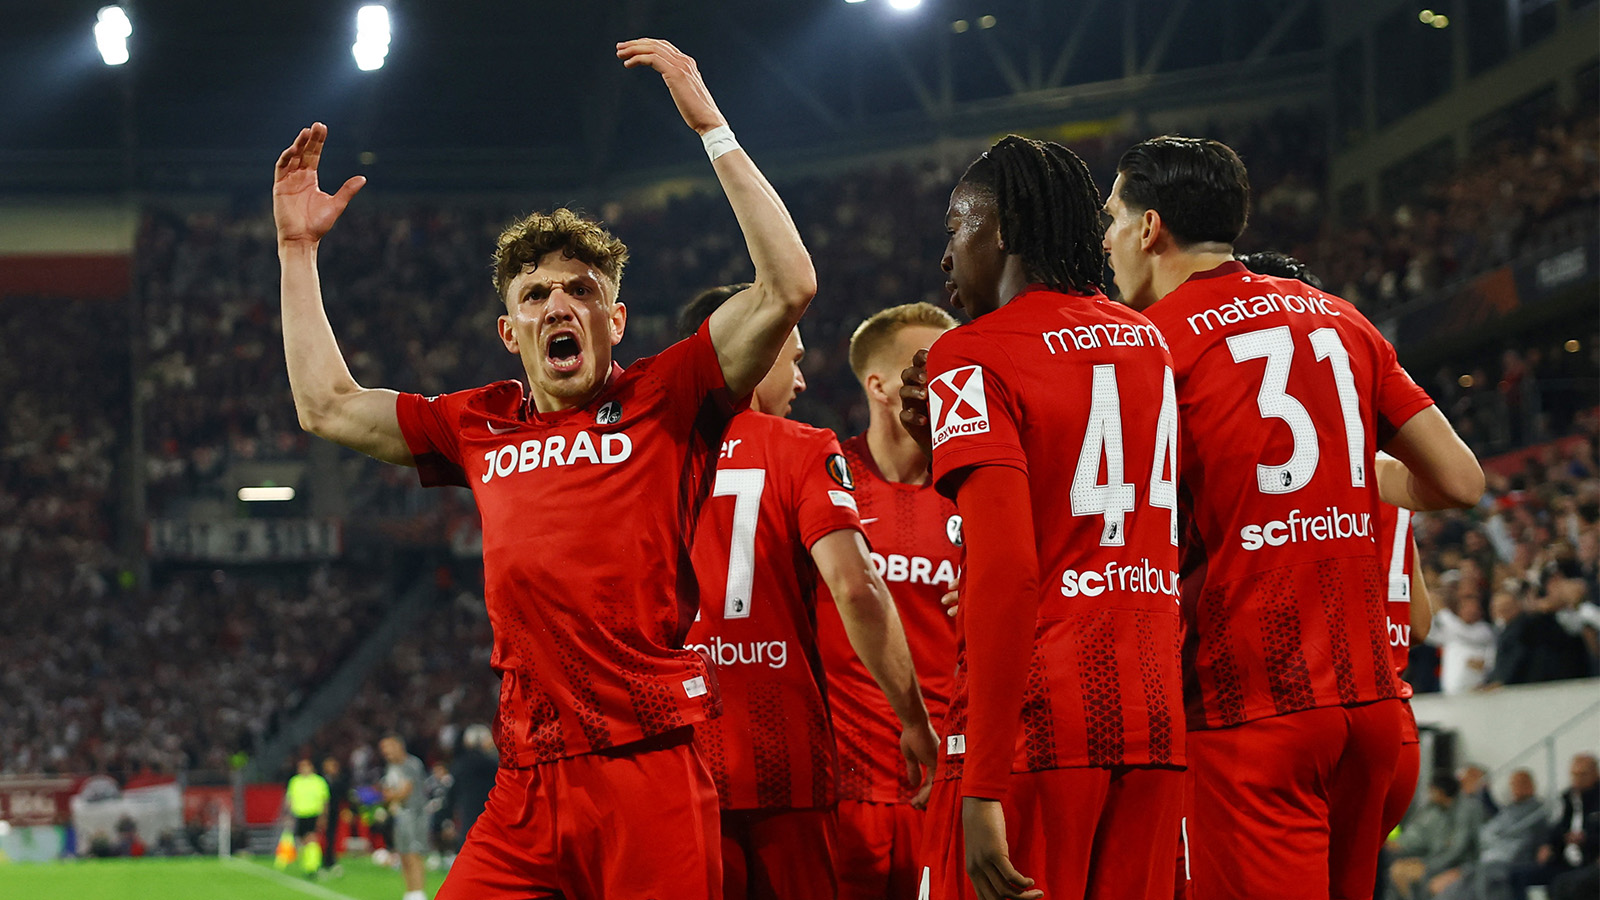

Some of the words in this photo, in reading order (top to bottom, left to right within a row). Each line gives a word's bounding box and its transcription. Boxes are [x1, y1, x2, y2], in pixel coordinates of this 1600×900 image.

[1186, 290, 1341, 336] matanović
[1042, 323, 1170, 354] manzam
[1225, 325, 1366, 495] 31
[933, 420, 988, 447] Lexware
[1069, 363, 1179, 547] 44
[481, 431, 633, 484] JOBRAD
[695, 467, 766, 621] 7
[1240, 506, 1376, 551] scfreibur
[869, 551, 962, 586] OBRA
